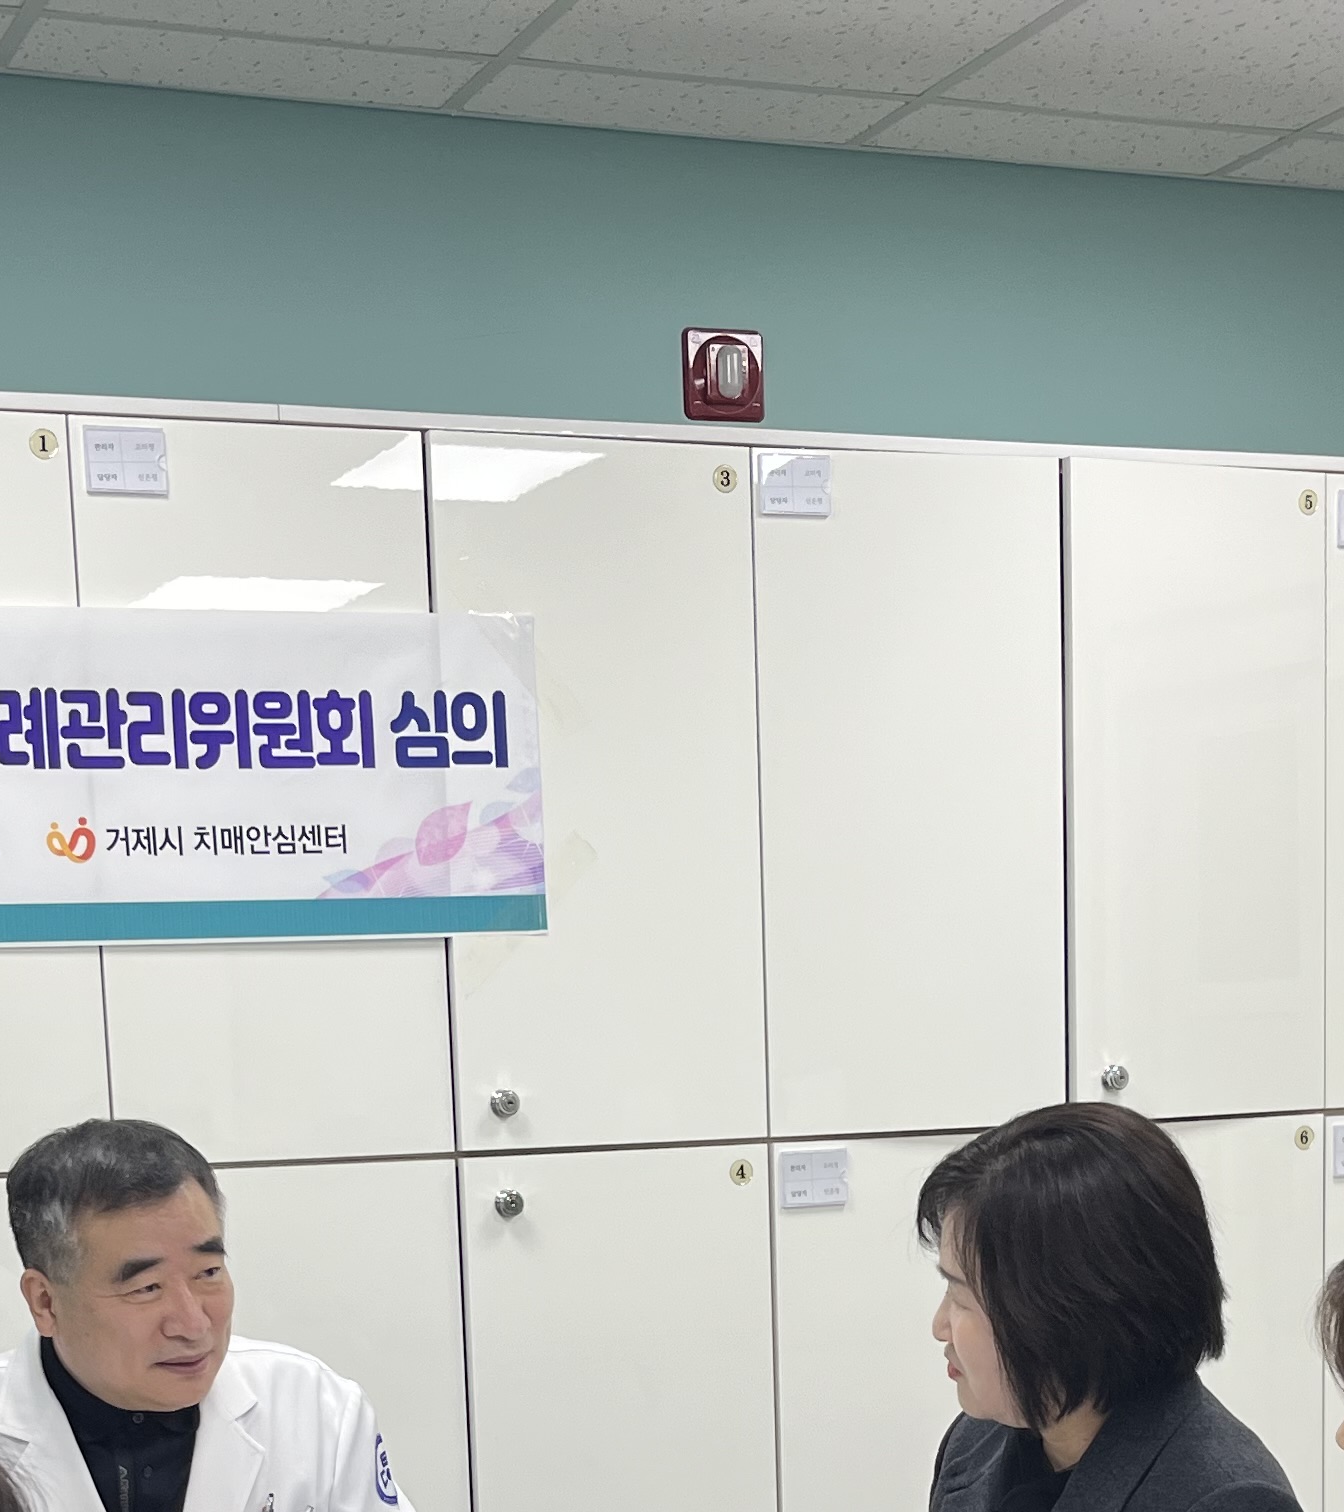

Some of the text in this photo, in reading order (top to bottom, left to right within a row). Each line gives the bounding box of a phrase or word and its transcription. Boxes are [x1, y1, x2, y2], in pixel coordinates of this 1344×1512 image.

[39, 435, 48, 452] 1
[720, 470, 731, 487] 3
[1304, 494, 1313, 510] 5
[389, 689, 510, 770] 심의
[104, 820, 349, 858] 거제시 치매안심센터
[1300, 1130, 1309, 1145] 6
[735, 1164, 747, 1180] 4
